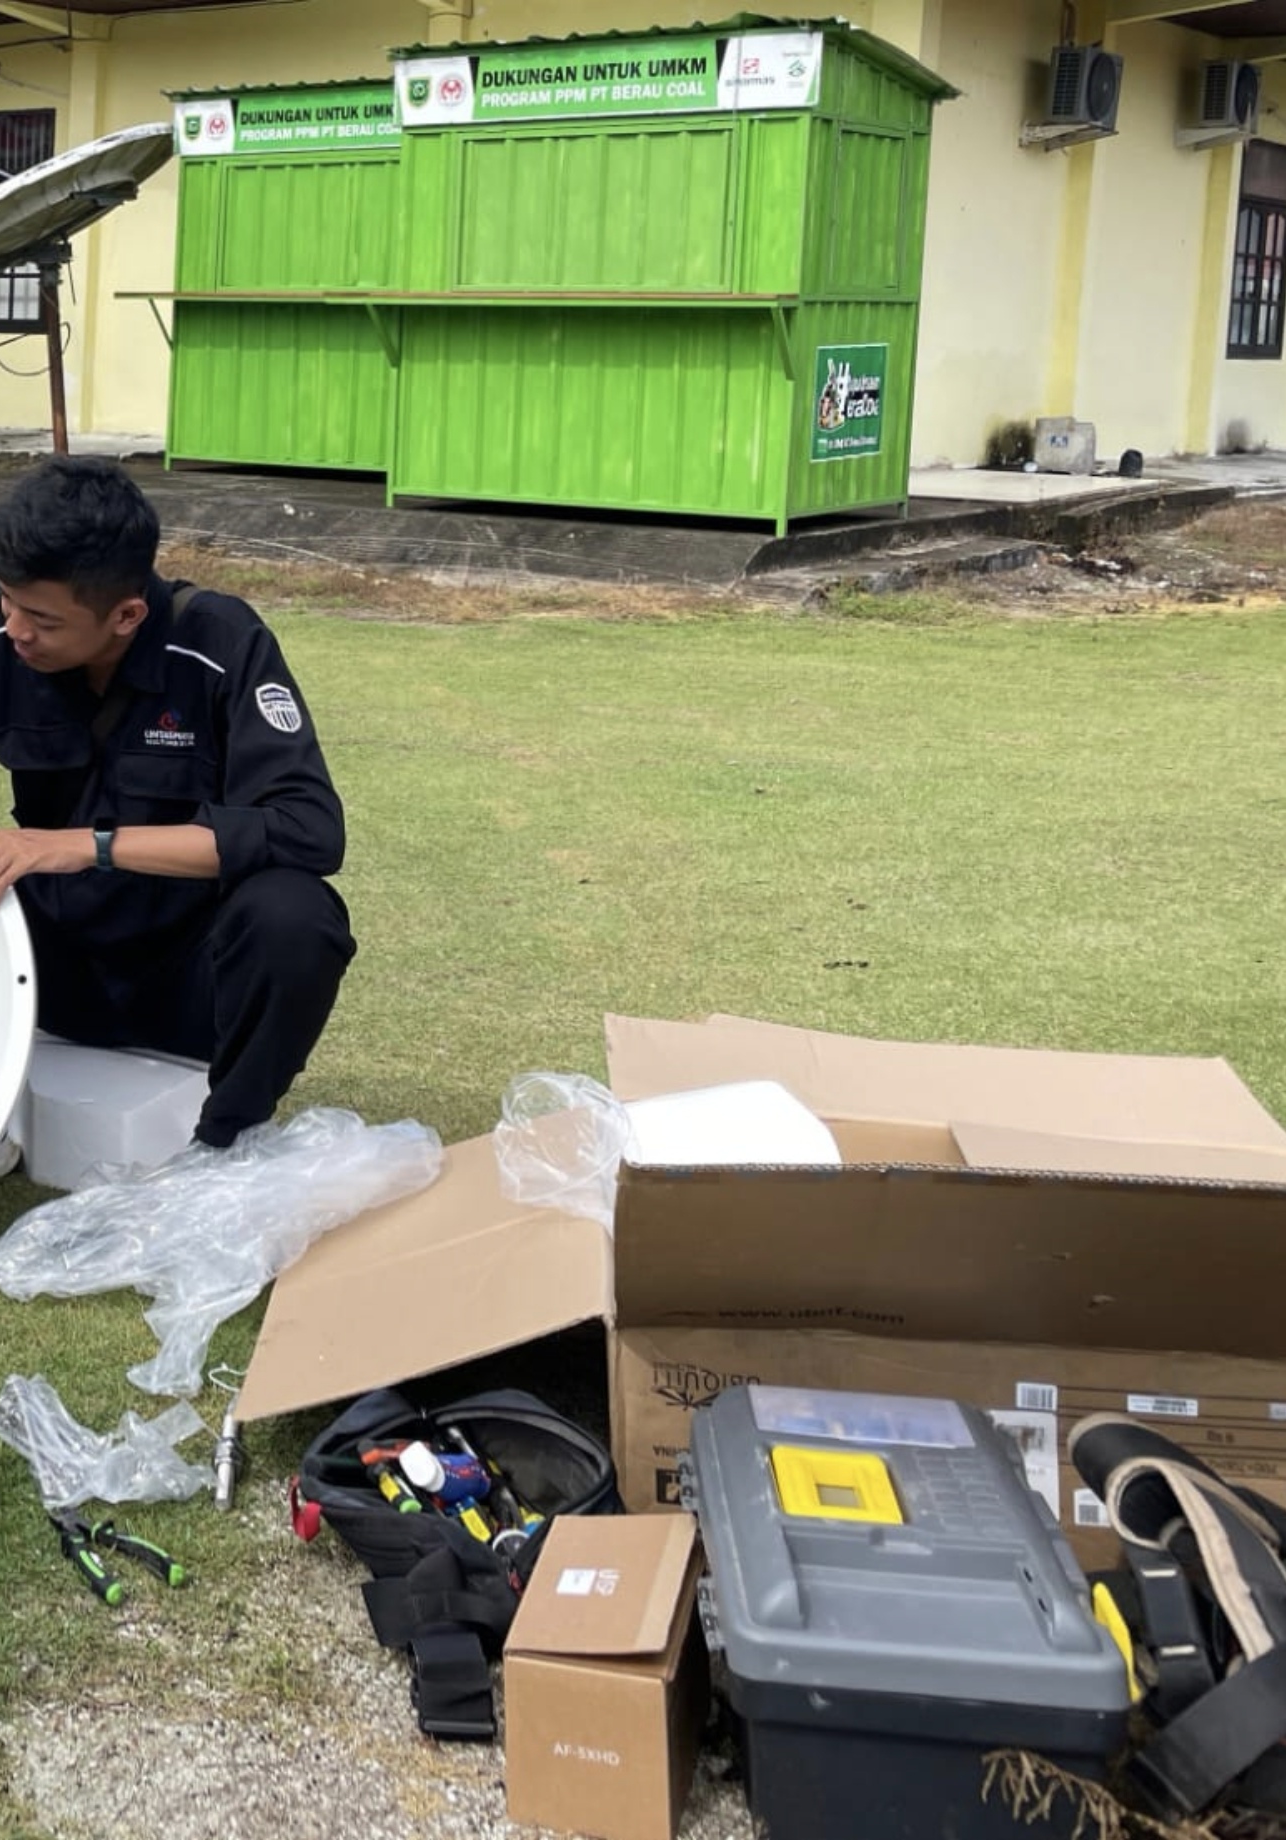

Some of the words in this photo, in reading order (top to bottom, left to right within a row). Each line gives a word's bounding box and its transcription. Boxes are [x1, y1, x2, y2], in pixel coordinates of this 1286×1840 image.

[482, 66, 577, 88] DUKUNGAN
[584, 61, 641, 82] UNTUK
[649, 56, 707, 77] UMKM
[481, 90, 551, 108] PROGRAM
[554, 87, 587, 104] PPM
[591, 86, 607, 102] PT
[612, 83, 661, 99] BERAU
[666, 80, 706, 97] COAL
[240, 109, 312, 125] DUKUNGAN
[316, 105, 359, 121] UNTUK
[365, 103, 394, 119] UMK
[240, 127, 293, 142] PROGRAM
[296, 126, 320, 139] PPM
[323, 125, 335, 138] PT
[338, 123, 375, 137] BERAU
[553, 1742, 620, 1767] AF-5XHD
